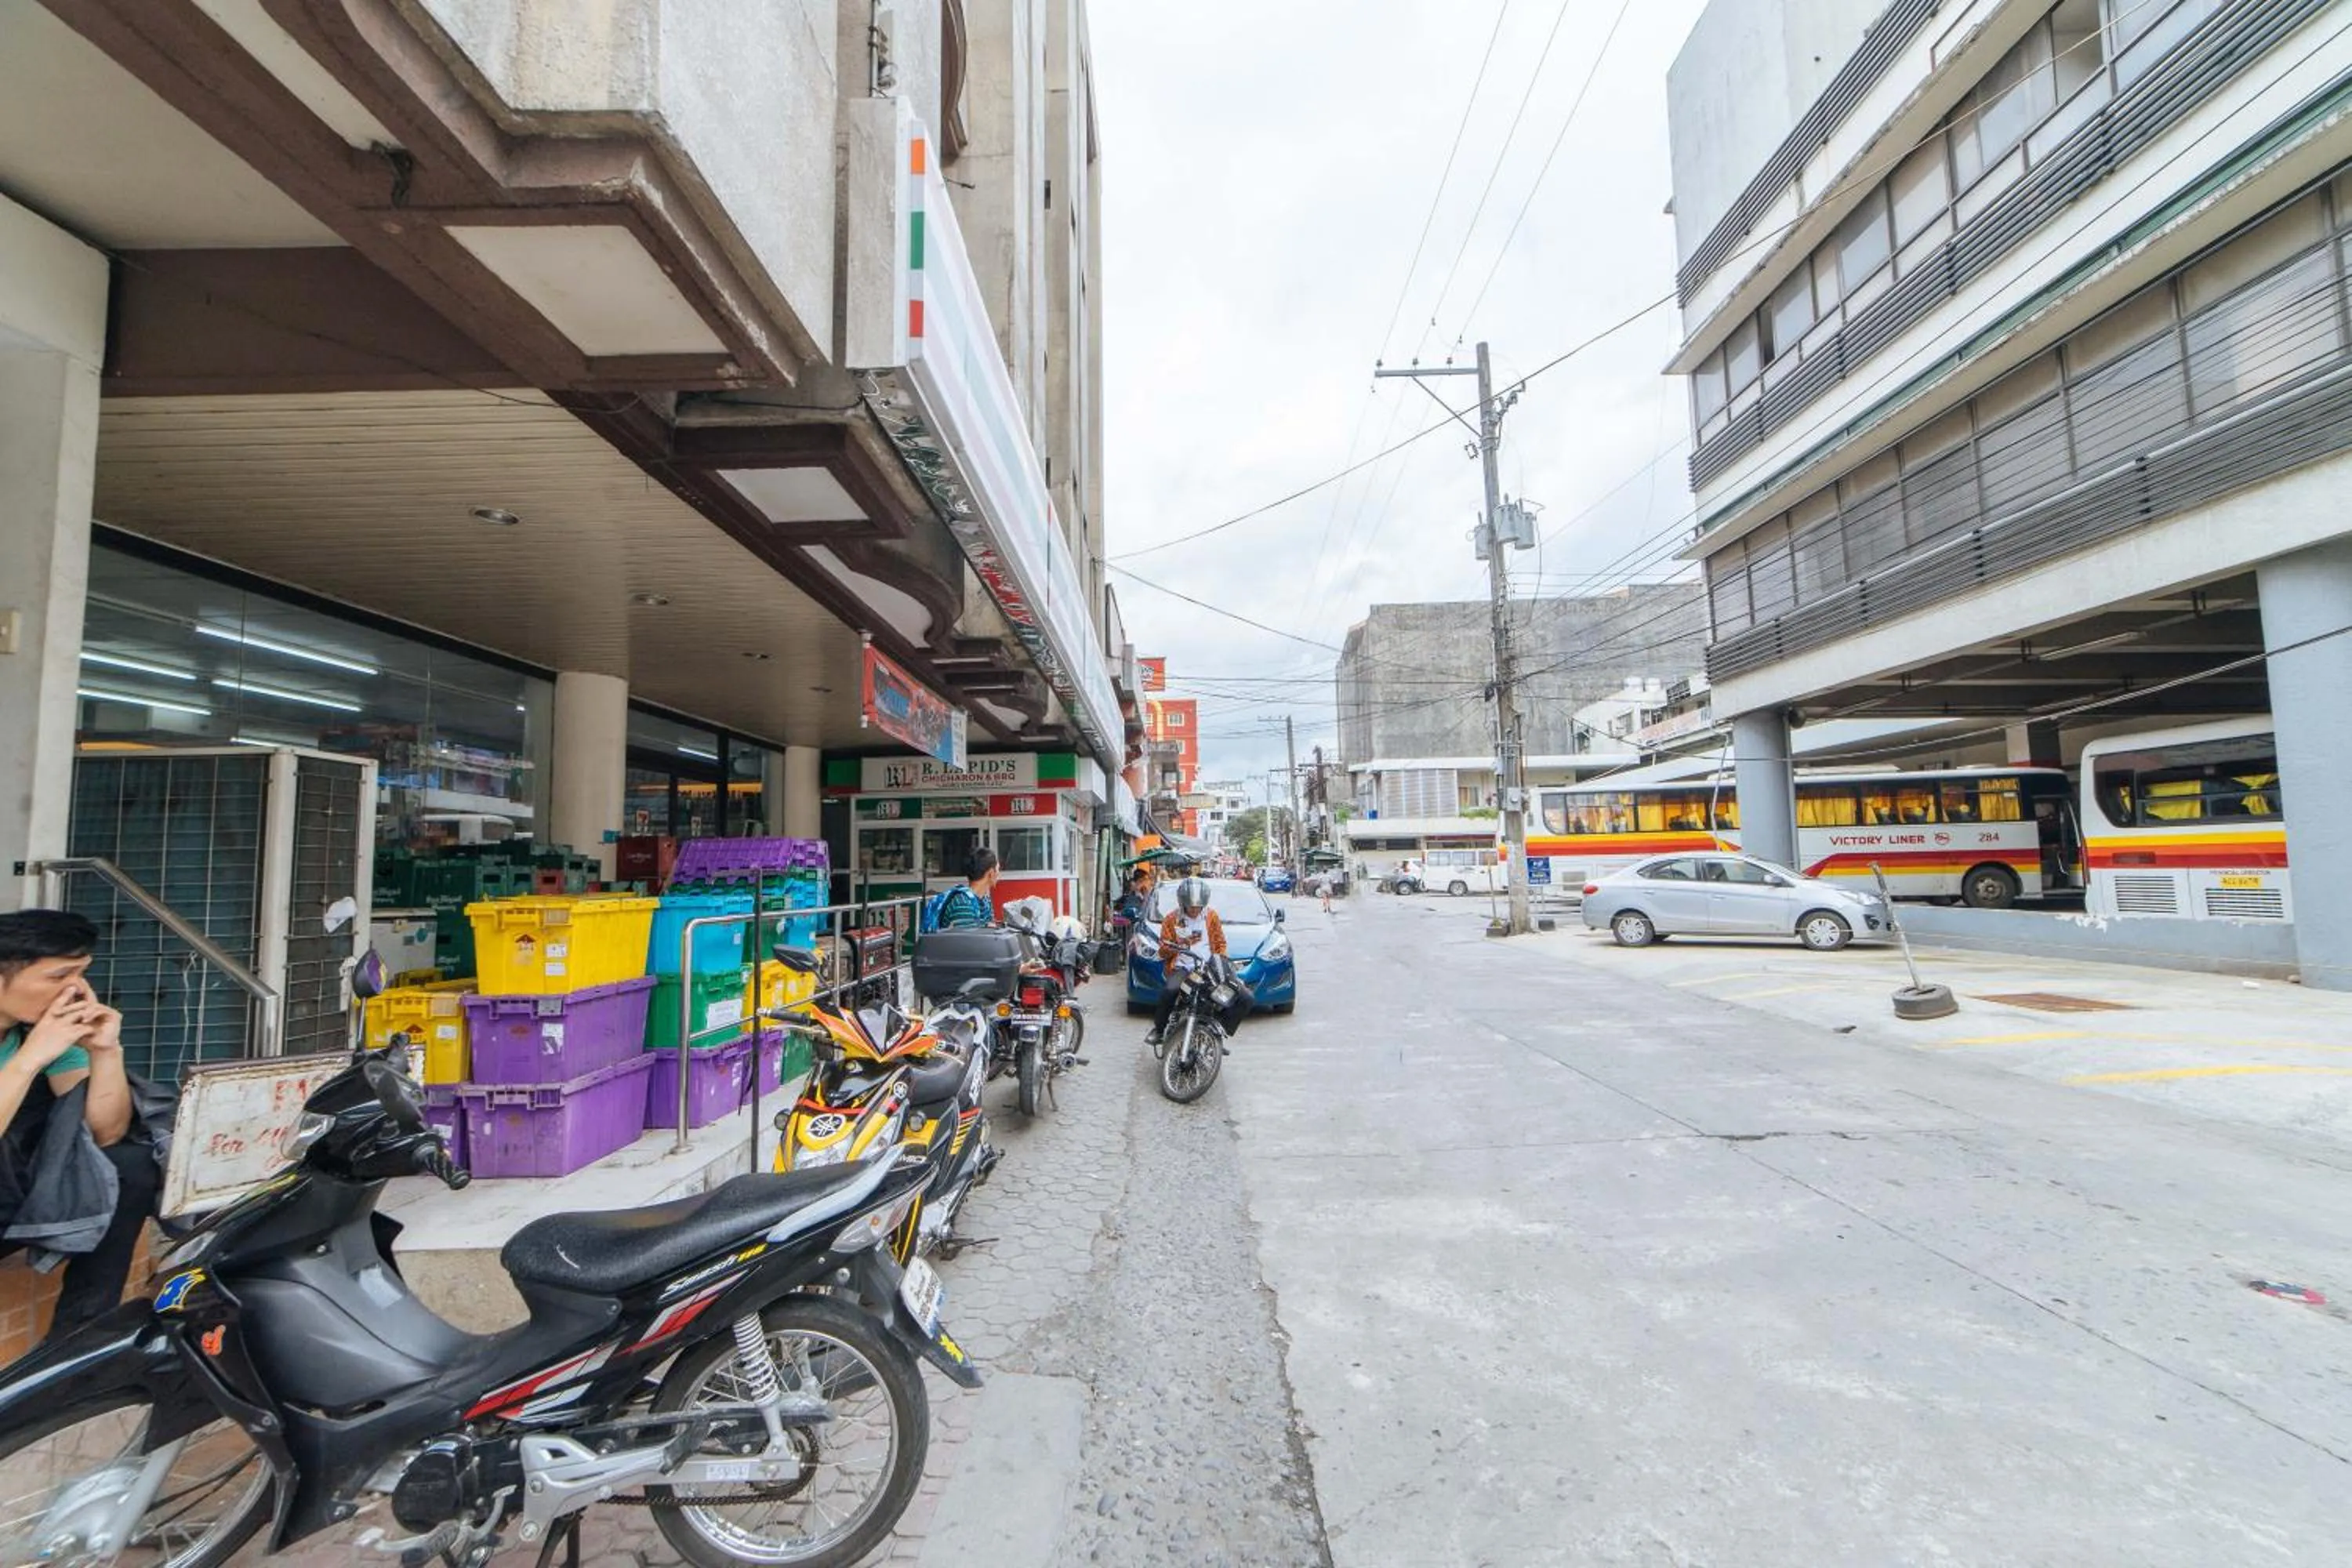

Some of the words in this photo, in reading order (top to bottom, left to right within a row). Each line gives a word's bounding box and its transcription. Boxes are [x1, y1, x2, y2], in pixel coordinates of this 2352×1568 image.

[923, 763, 938, 774] R.
[943, 760, 1016, 774] LPID'S
[921, 773, 983, 783] CHICHARON
[1829, 835, 1882, 846] VICTORY
[1889, 834, 1926, 844] LINER
[1979, 833, 1999, 843] 284
